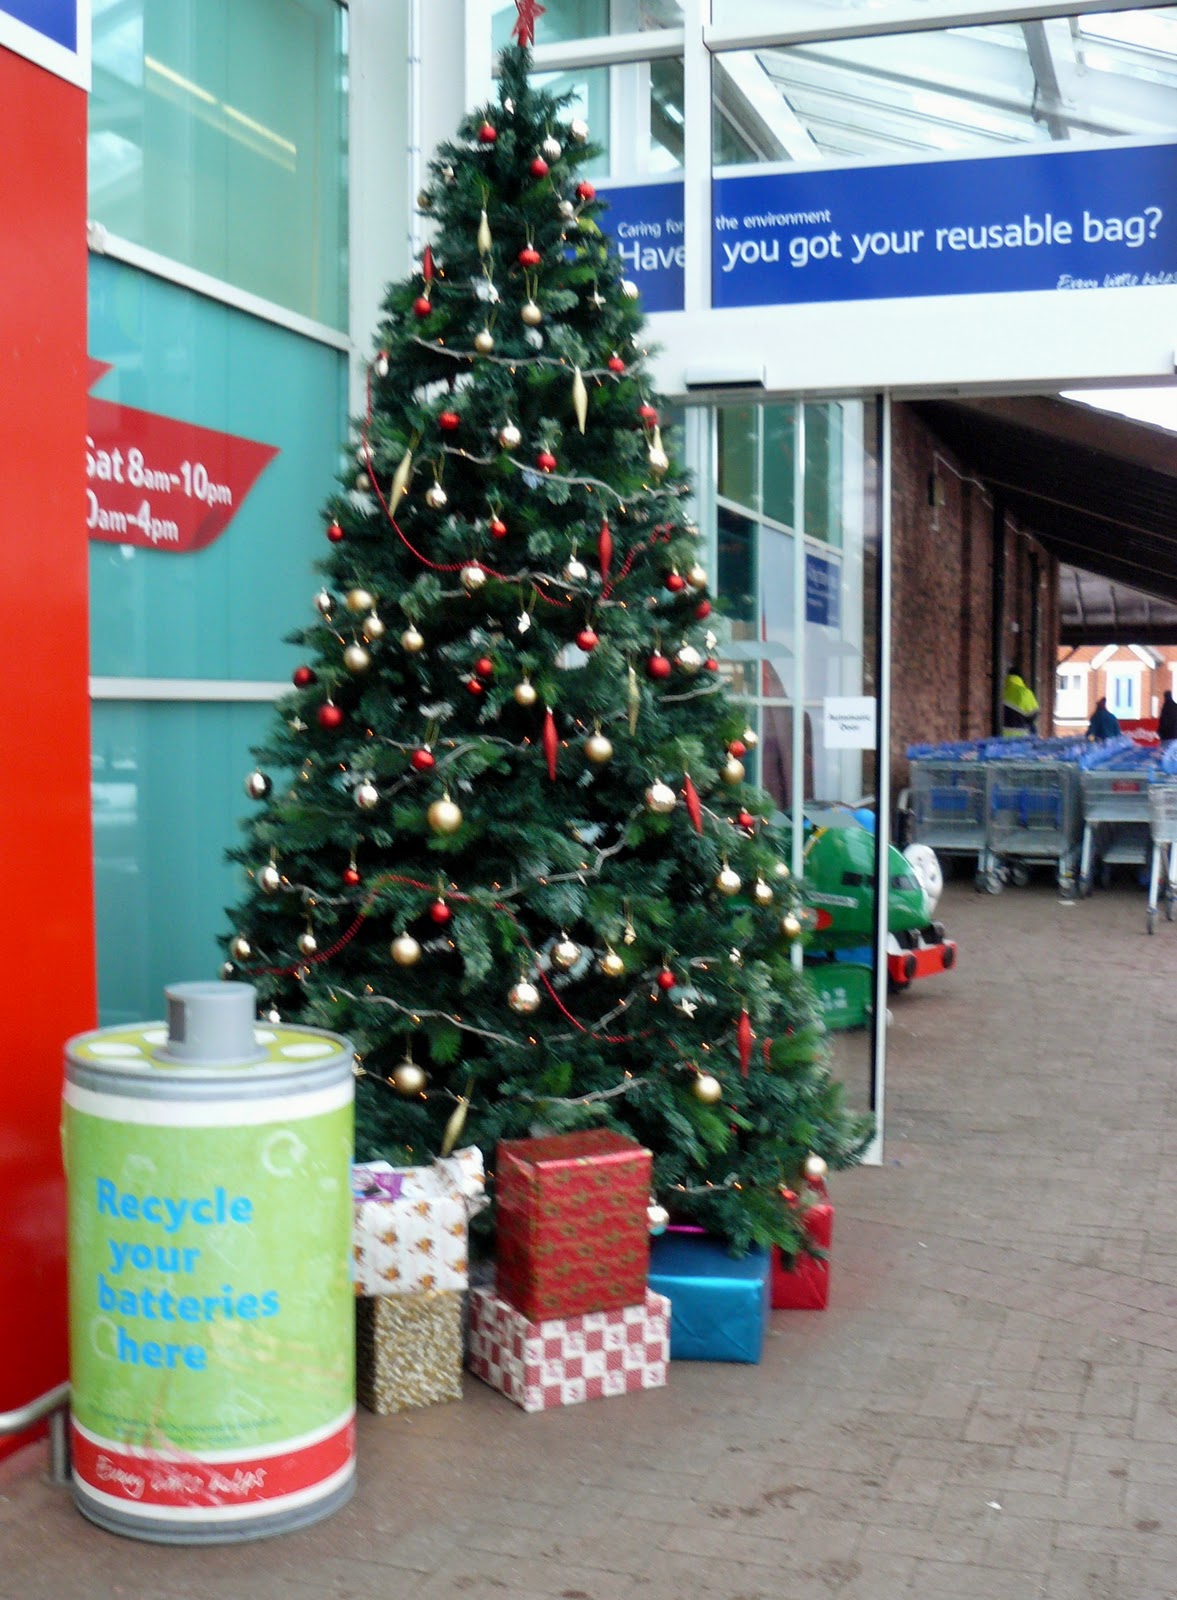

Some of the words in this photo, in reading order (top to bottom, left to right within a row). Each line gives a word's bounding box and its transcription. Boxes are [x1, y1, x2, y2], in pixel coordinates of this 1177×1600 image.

[618, 221, 661, 238] Caring
[715, 214, 738, 231] the
[743, 209, 831, 228] environment
[618, 240, 684, 271] Have
[722, 239, 779, 272] you
[789, 231, 842, 267] got
[851, 230, 924, 264] your
[936, 213, 1073, 251] reusable
[1083, 206, 1163, 248] bag?
[95, 1177, 253, 1234] Recycle
[108, 1238, 202, 1275] your
[95, 1274, 281, 1322] batteries
[115, 1325, 208, 1372] here
